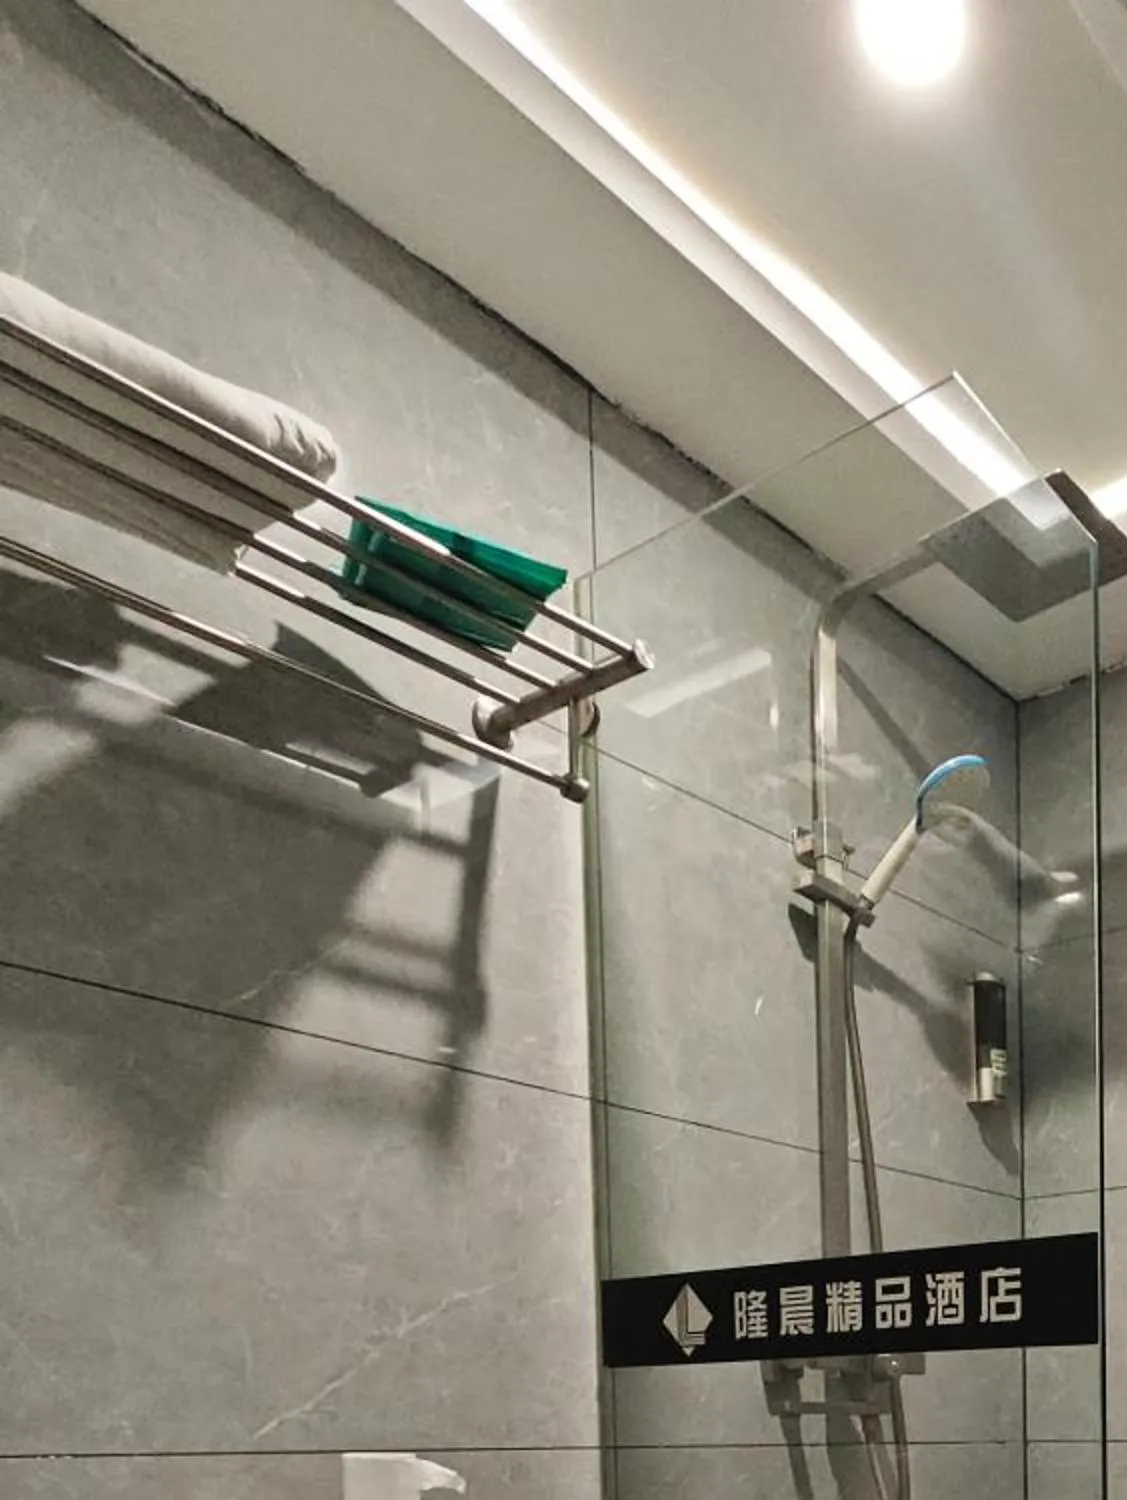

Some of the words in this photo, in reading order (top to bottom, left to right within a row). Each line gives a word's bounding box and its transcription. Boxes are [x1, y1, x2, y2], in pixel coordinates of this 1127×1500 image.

[733, 1267, 1022, 1340] 隆晨精品酒店
